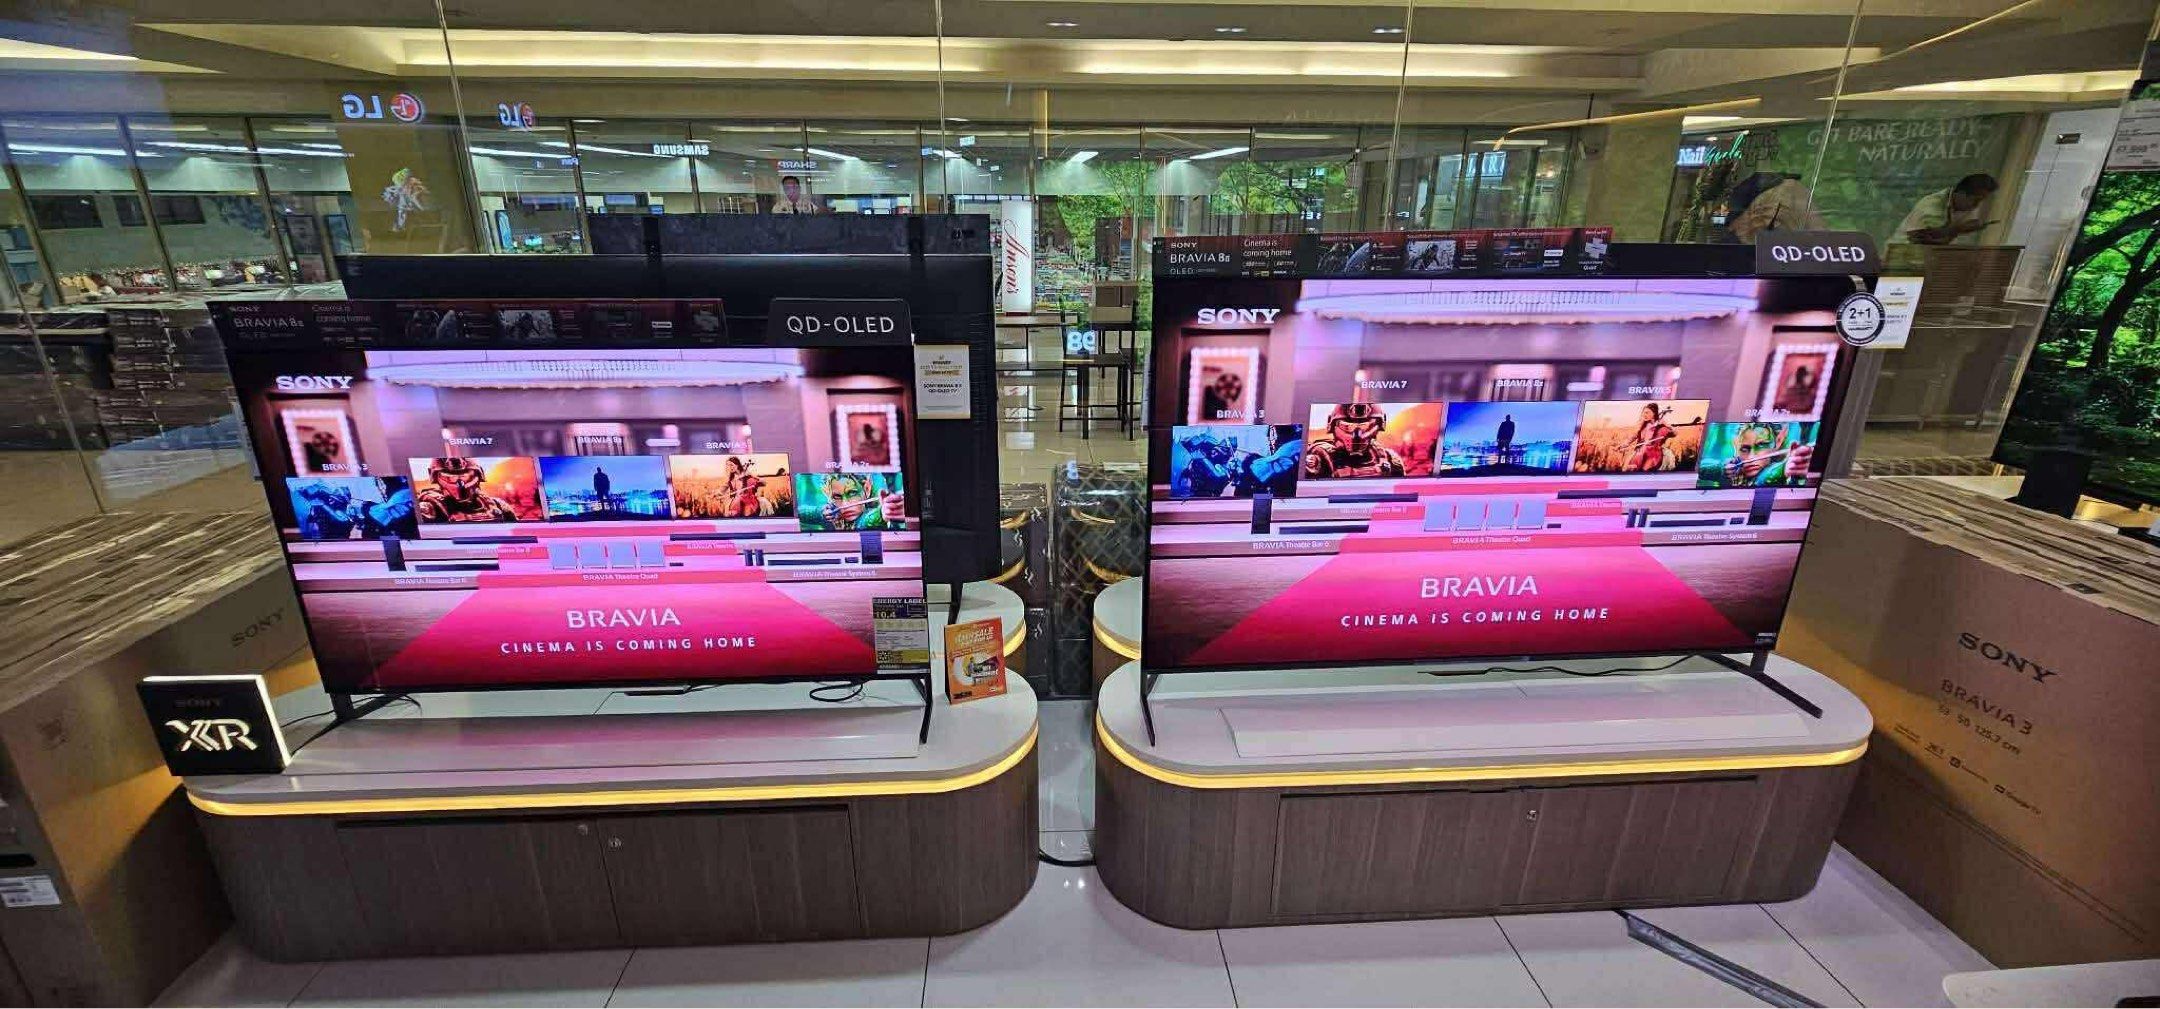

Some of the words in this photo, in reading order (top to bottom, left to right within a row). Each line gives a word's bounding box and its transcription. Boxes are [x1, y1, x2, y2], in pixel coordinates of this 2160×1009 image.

[1848, 122, 1901, 142] BARE
[1677, 146, 1706, 165] Nail
[1003, 219, 1029, 294] Anson's
[1170, 254, 1215, 264] BRAVIA
[1243, 250, 1269, 258] coming
[1772, 246, 1865, 263] QD-OLED
[1197, 307, 1281, 325] SONY
[1850, 307, 1871, 320] 2+1
[234, 317, 289, 328] BRAVIA
[787, 315, 895, 334] QD-OLED
[276, 375, 353, 390] SONY
[1361, 380, 1400, 389] BRAVIA
[1401, 380, 1407, 388] 7
[1496, 379, 1533, 387] BRAVIA
[1628, 386, 1666, 394] BRAVIA
[1259, 410, 1266, 418] 3
[450, 437, 486, 445] BRAVIA
[577, 436, 613, 444] BRAVIA
[706, 441, 741, 449] BRAVIA
[1252, 541, 1285, 550] BRAVIA
[1420, 576, 1539, 598] BRAVIA
[566, 608, 682, 628] BRAVIA
[1341, 613, 1419, 627] CINEMA
[1431, 612, 1450, 624] IS
[1462, 610, 1542, 623] COMING
[1554, 608, 1609, 620] HOME
[231, 608, 284, 647] SONY
[501, 641, 575, 654] CINEMA
[587, 640, 604, 651] IS
[616, 638, 692, 651] COMING
[704, 637, 756, 648] HOME
[1958, 631, 2058, 684] SONY
[1940, 679, 2016, 729] BRAVIA
[2019, 720, 2033, 735] 3
